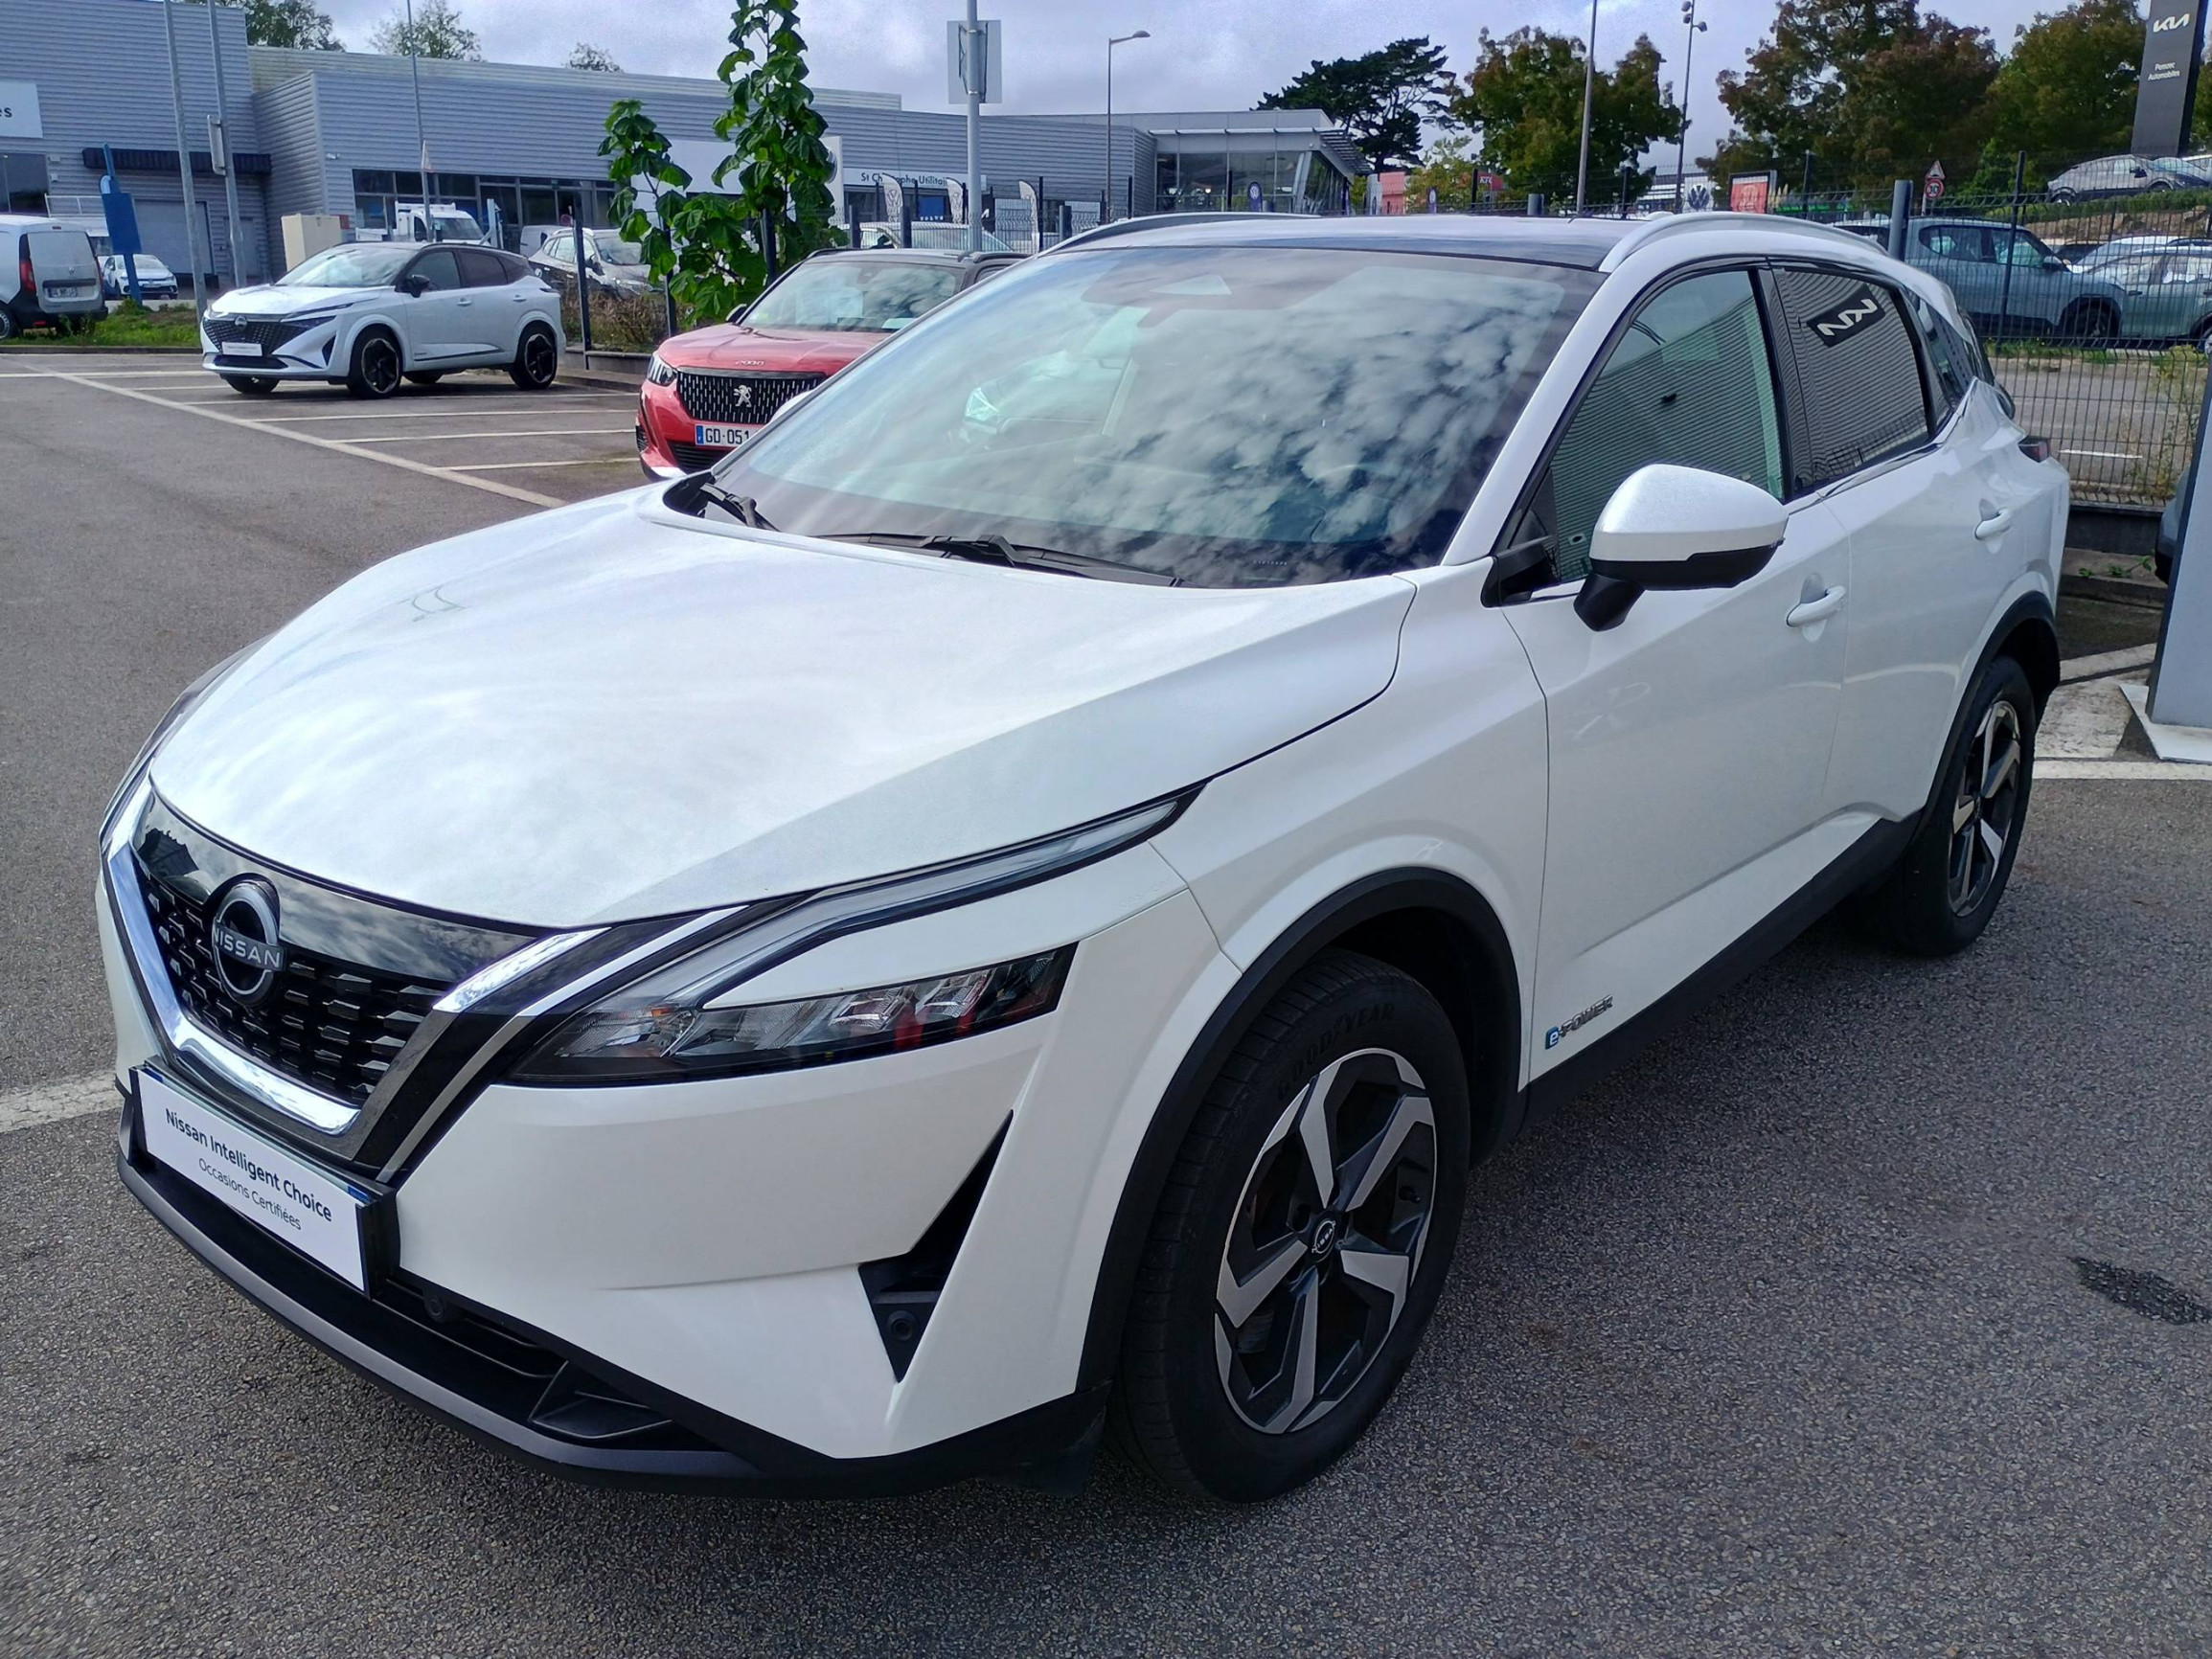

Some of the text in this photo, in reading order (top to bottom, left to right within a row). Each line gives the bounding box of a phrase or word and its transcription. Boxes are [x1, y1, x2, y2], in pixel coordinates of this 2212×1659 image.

[860, 172, 870, 182] St
[213, 926, 281, 968] NISSAN
[165, 1107, 332, 1222] Nissan Intelligent Choice
[197, 1157, 302, 1231] Occasions Certifiées
